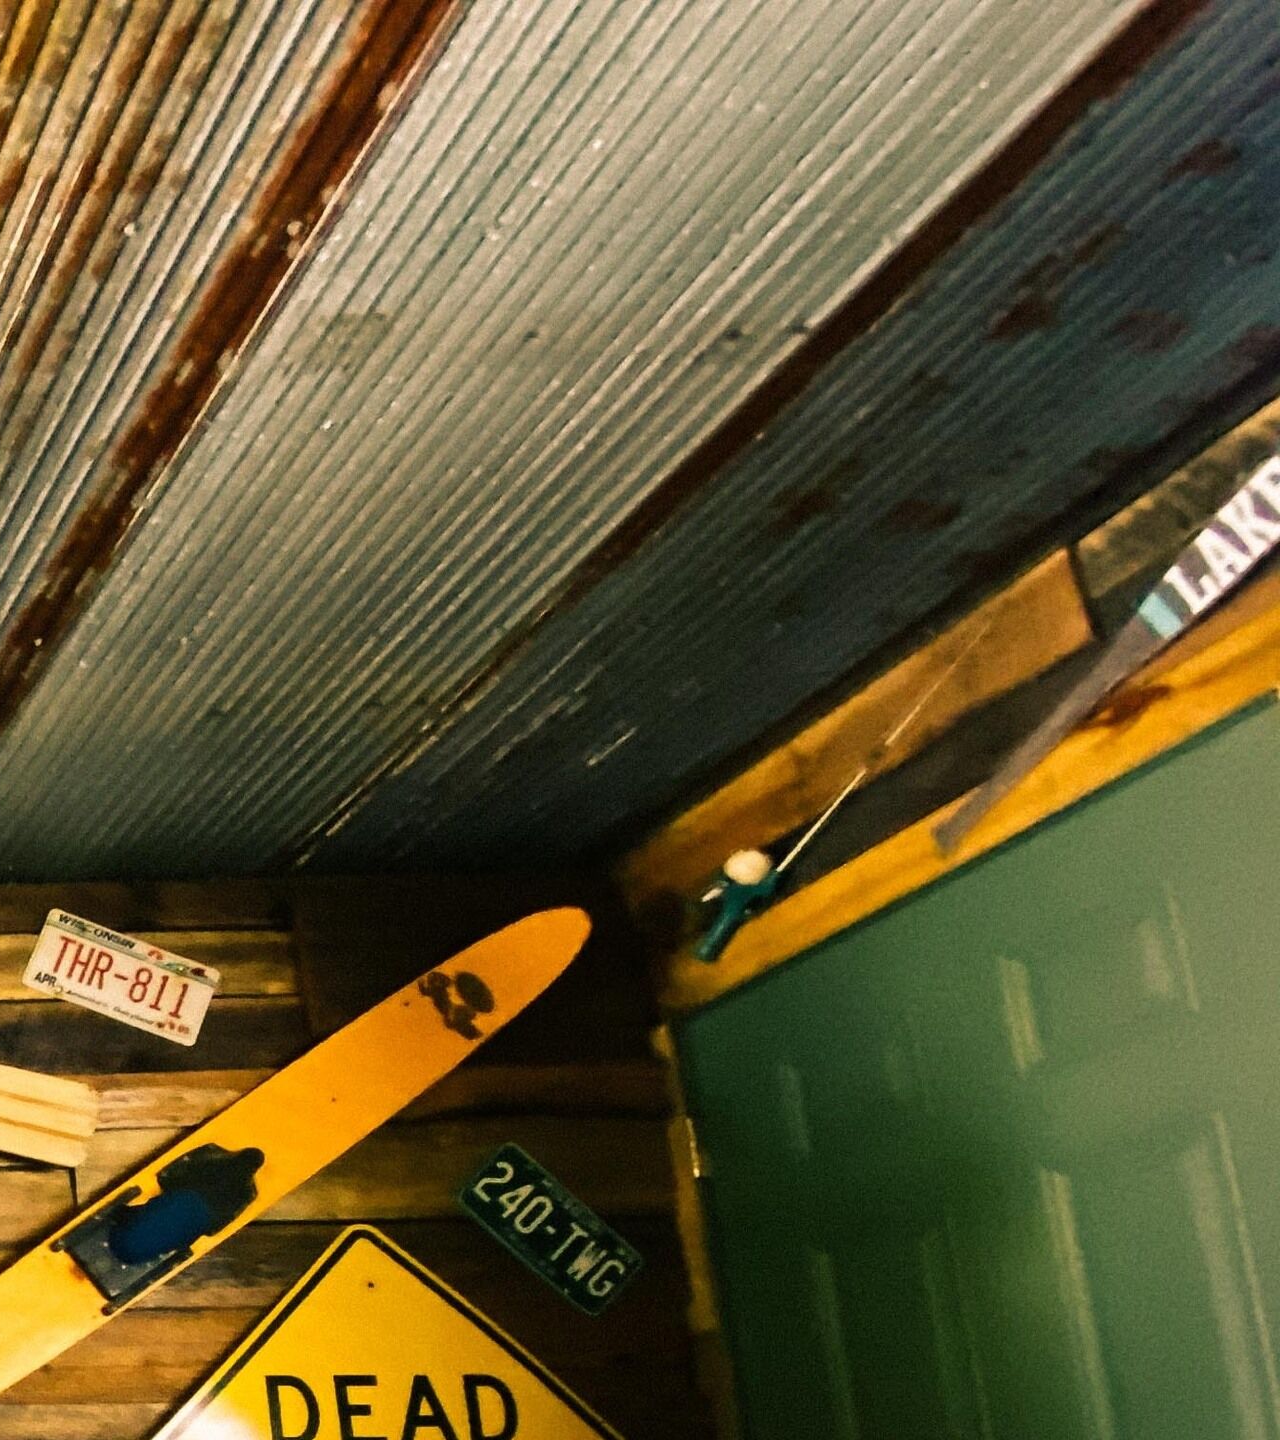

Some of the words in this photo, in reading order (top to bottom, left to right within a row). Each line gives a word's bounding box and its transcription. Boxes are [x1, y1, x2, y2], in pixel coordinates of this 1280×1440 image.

[33, 971, 57, 988] APR
[52, 936, 189, 1020] THR-811
[473, 1161, 626, 1298] 240-TWG
